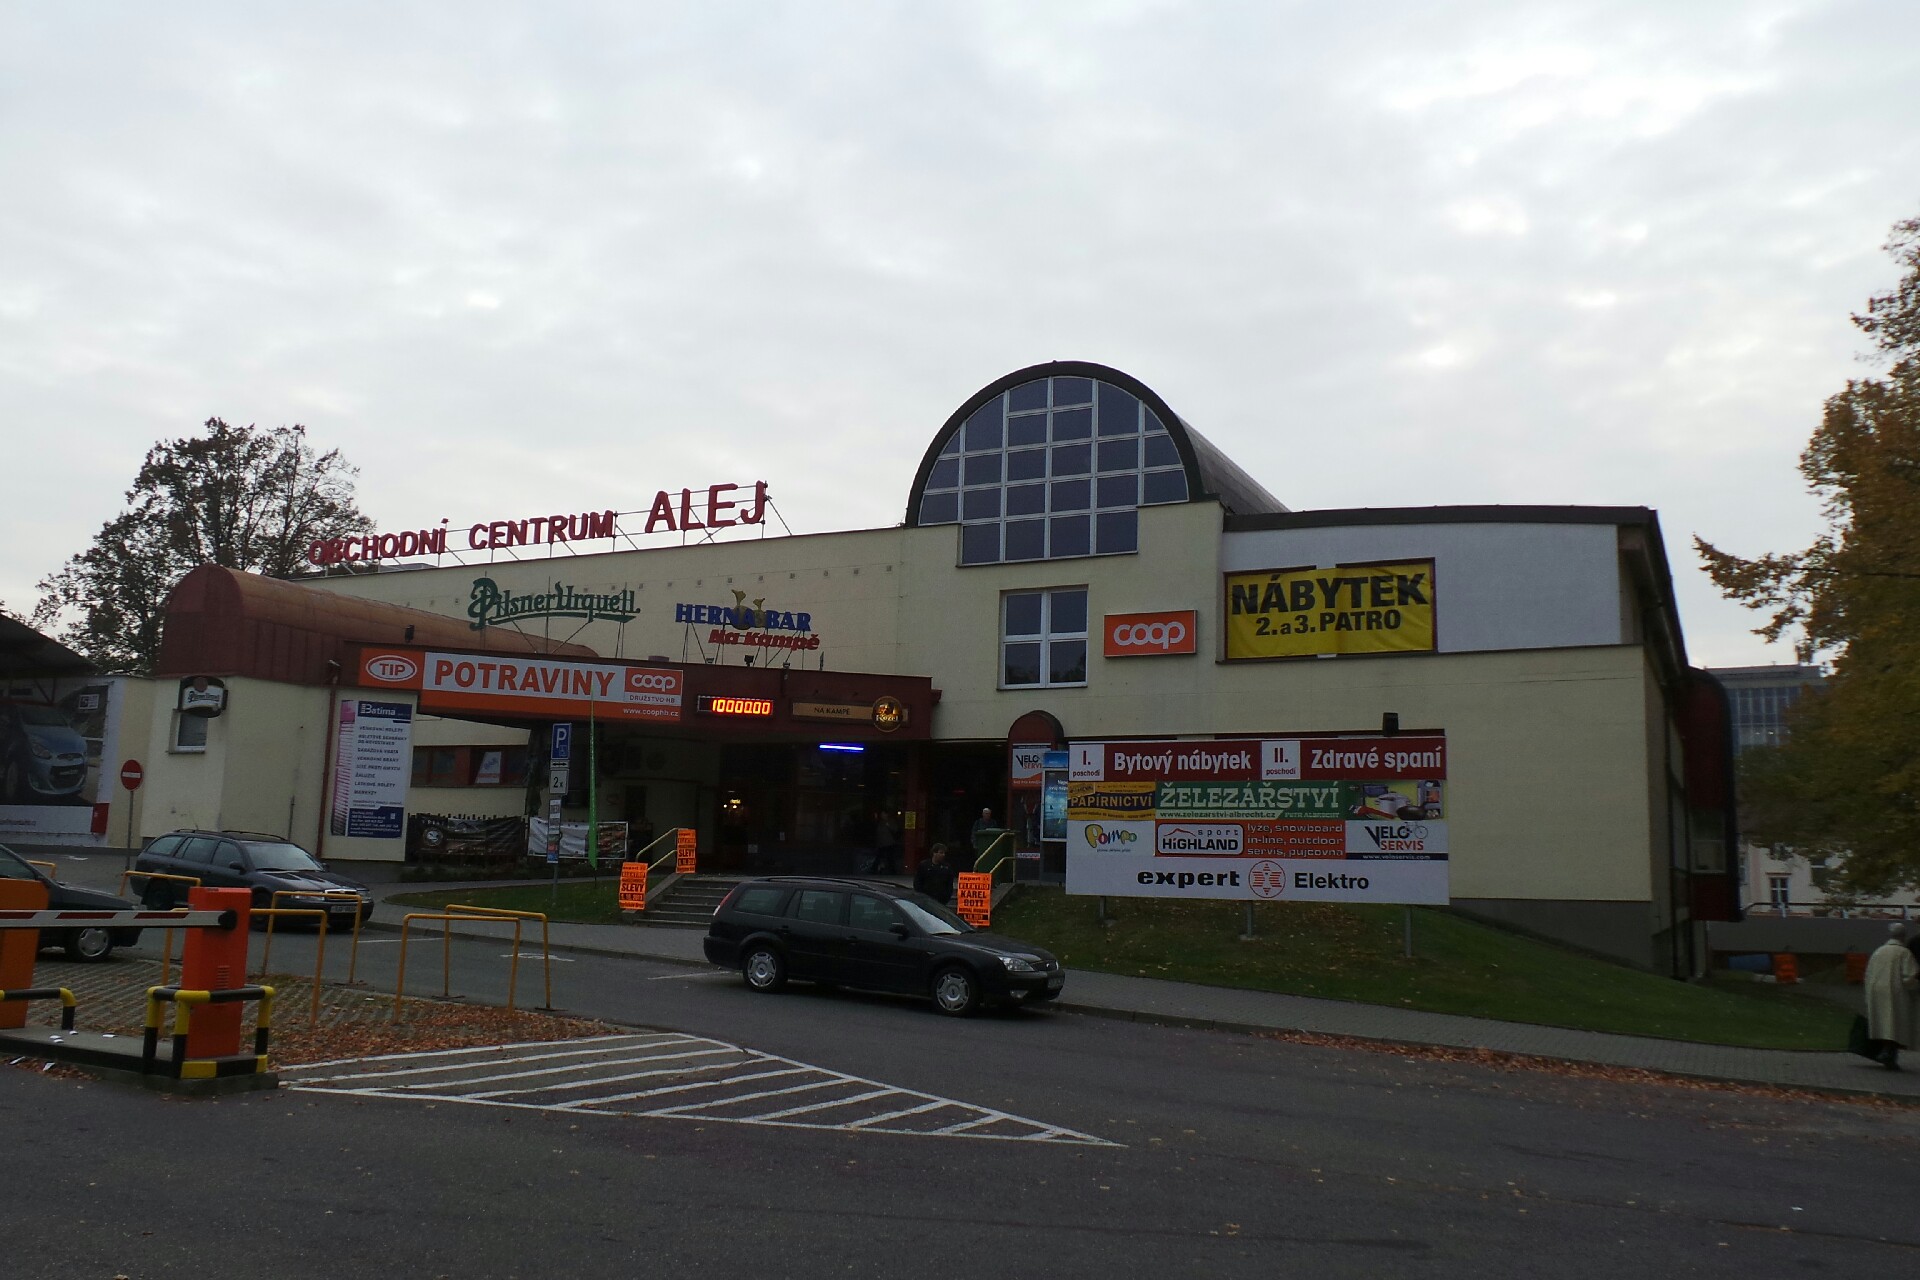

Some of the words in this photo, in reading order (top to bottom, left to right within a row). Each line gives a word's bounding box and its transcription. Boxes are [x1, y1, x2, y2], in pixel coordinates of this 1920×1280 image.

[308, 518, 448, 565] OBCHODNÍ
[469, 510, 614, 550] CENTRUM
[645, 480, 767, 533] ALEJ
[1231, 573, 1429, 615] NÁBYTEK
[468, 577, 556, 631] Pilsner
[555, 581, 641, 623] Urquell
[675, 603, 756, 630] HERNA
[765, 609, 812, 631] BAR
[1320, 609, 1401, 632] PATRO
[708, 629, 741, 644] Na
[744, 632, 820, 651] Kampě
[1113, 620, 1186, 650] coop
[379, 663, 406, 676] TIP
[434, 659, 616, 698] POTRAVINY
[631, 673, 676, 692] coop
[629, 693, 664, 703] DRUŽSTVO
[360, 703, 396, 716] Batima
[623, 708, 679, 717] www.coophb.cz
[555, 728, 567, 750] P
[1016, 755, 1040, 768] VELO
[1114, 749, 1173, 775] Bytový
[1177, 749, 1252, 775] nábytek
[1274, 747, 1289, 763] II.
[1311, 746, 1379, 769] Zdravé
[1384, 746, 1442, 772] spaní
[1266, 767, 1296, 776] poschodí
[1070, 793, 1153, 807] PAPÍRNICTVÍ
[1159, 777, 1339, 808] ŽELEZÁŘSTVÍ
[1197, 828, 1239, 838] sport
[1275, 823, 1343, 832] snowboard
[1247, 834, 1287, 845] in-line,
[1289, 836, 1343, 845] outdoor
[1364, 825, 1411, 848] VELO
[1247, 846, 1287, 857] servis,
[1380, 840, 1424, 851] SERVIS
[621, 882, 644, 893] SLEVY
[1137, 869, 1240, 888] expert
[1294, 871, 1370, 890] Elektro
[960, 890, 986, 899] KAREL
